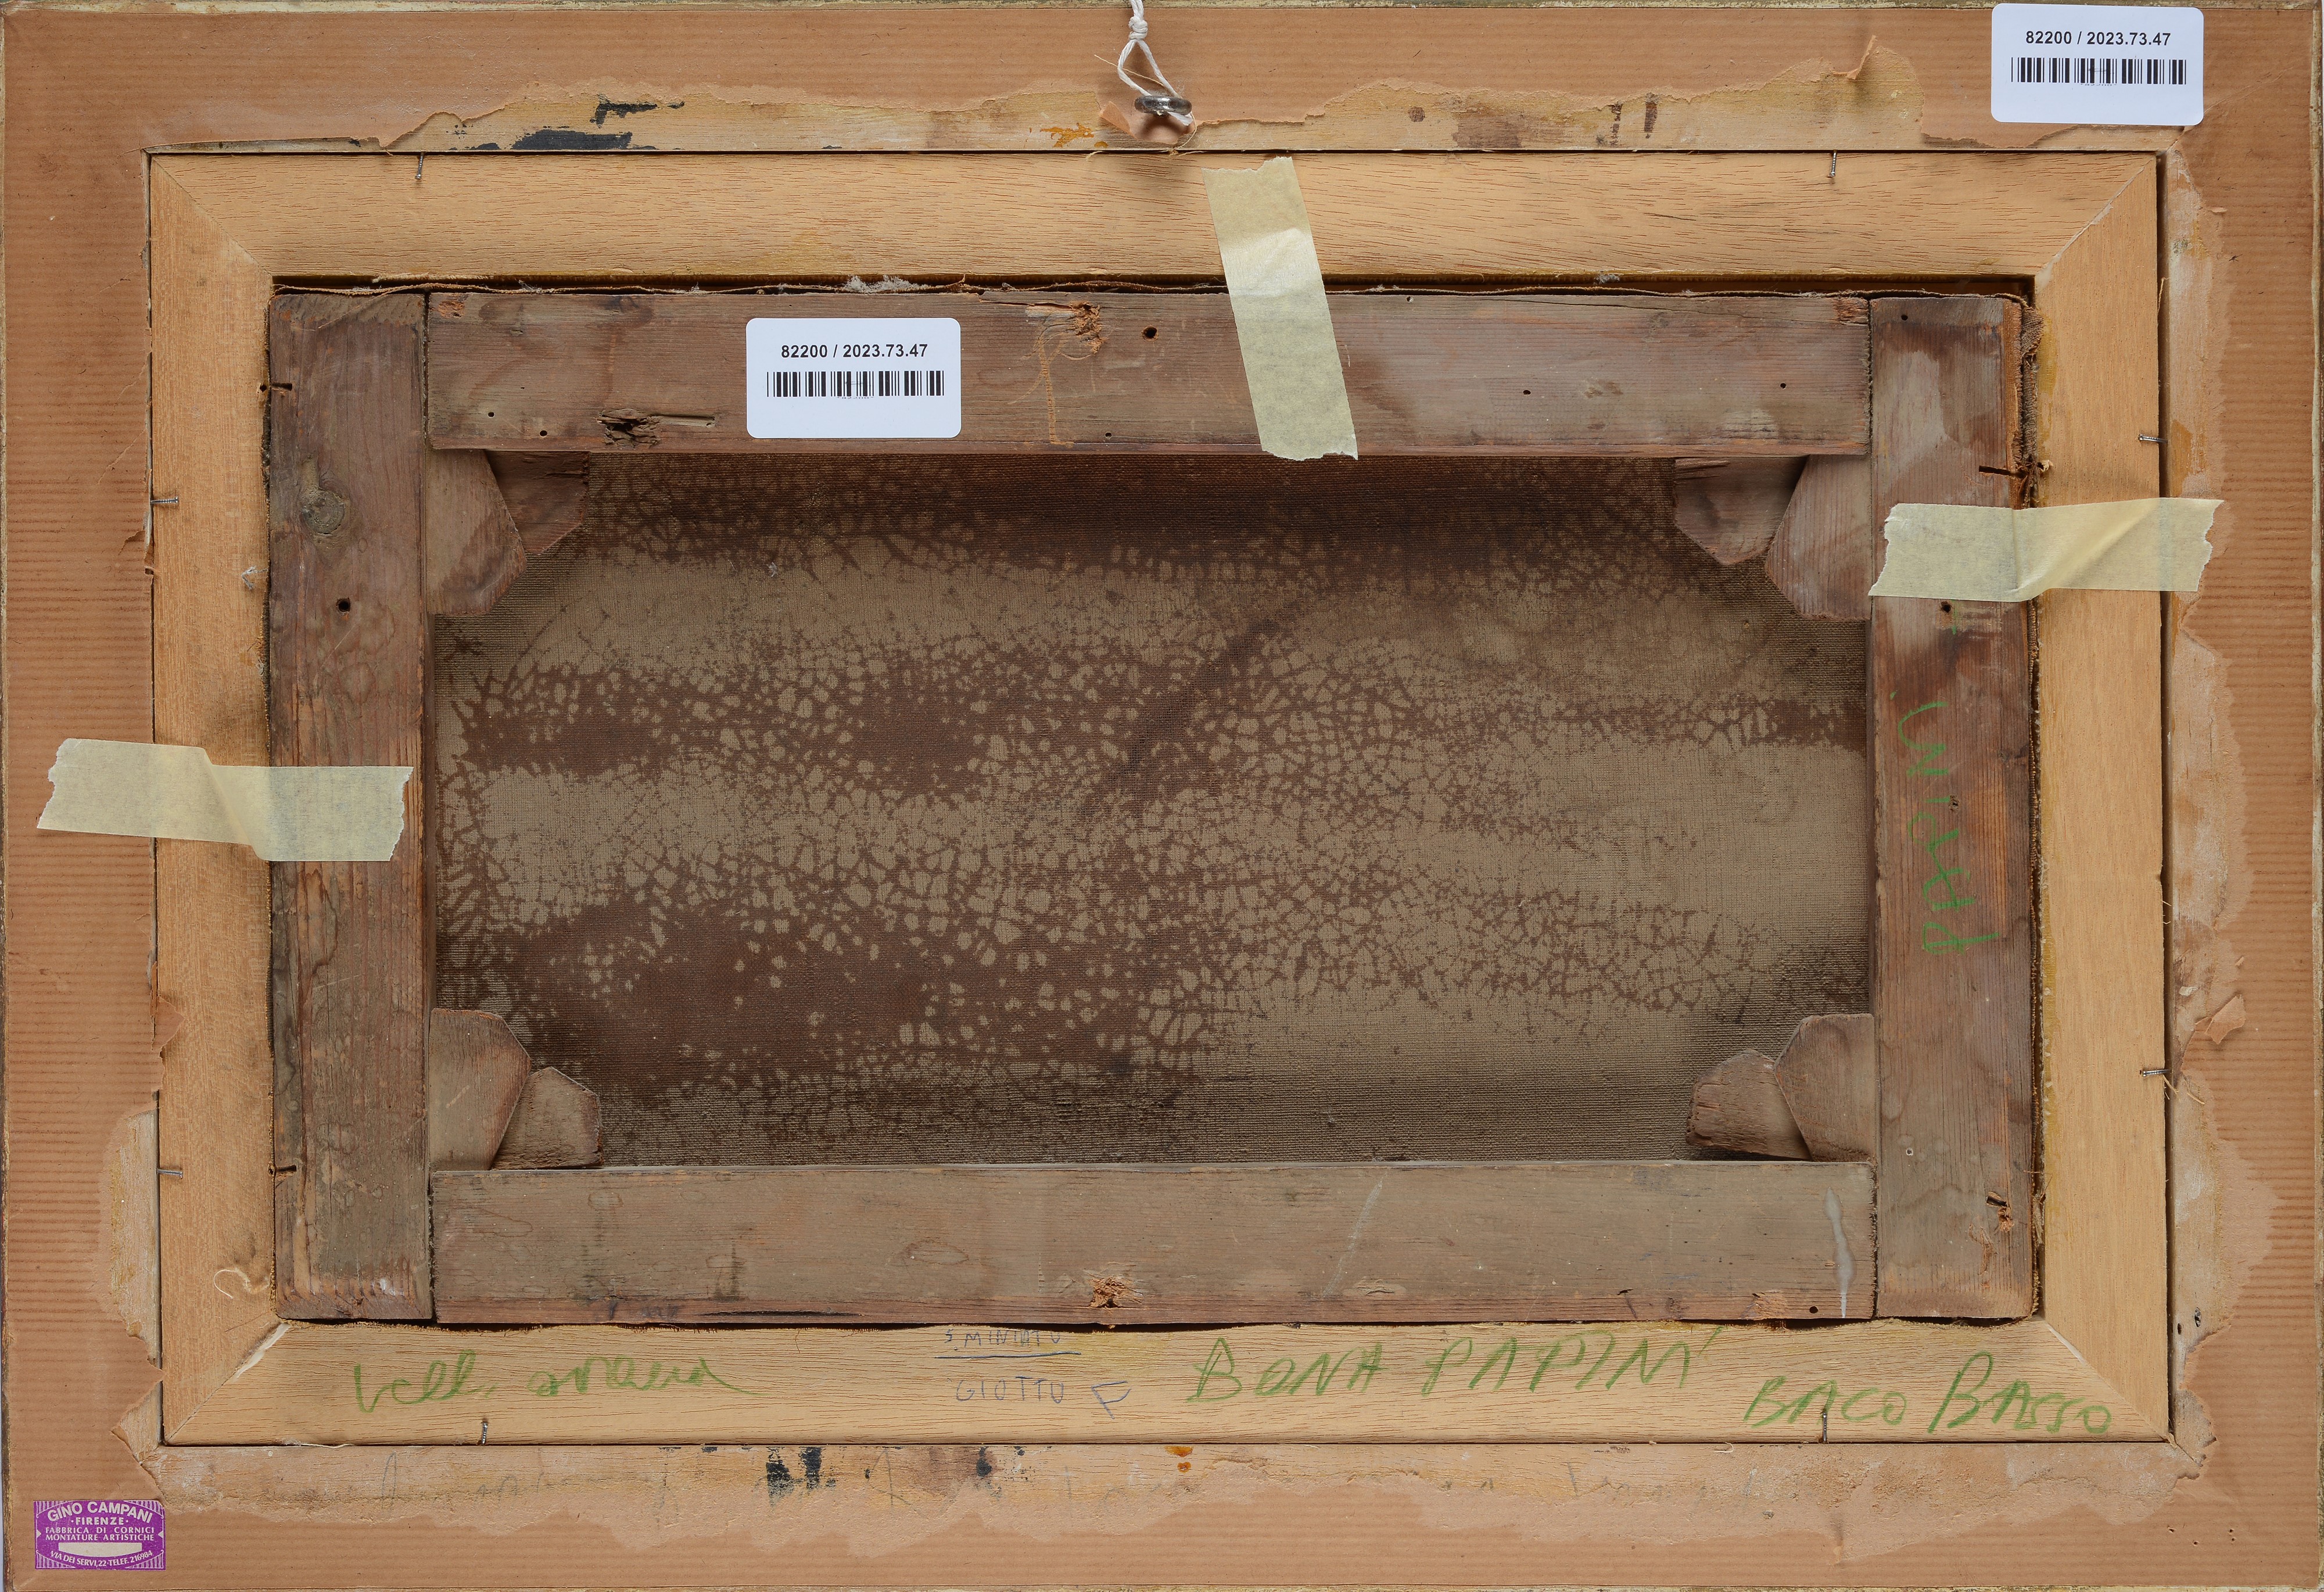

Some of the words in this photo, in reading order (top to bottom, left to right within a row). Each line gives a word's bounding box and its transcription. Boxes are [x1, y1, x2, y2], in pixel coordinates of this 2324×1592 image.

[2025, 31, 2072, 45] 82200
[2076, 31, 2082, 45] /
[2086, 32, 2172, 46] 2023.73.47
[781, 344, 828, 358] 82200
[833, 344, 838, 358] /
[842, 343, 928, 358] 2023.73.47
[1744, 1375, 1909, 1428] BACO
[1927, 1351, 2113, 1434] BASSO
[47, 1502, 83, 1522] GINO
[87, 1501, 153, 1523] CAMPANI
[50, 1550, 62, 1560] VIA
[63, 1555, 76, 1564] DEI
[130, 1550, 153, 1564] 216984
